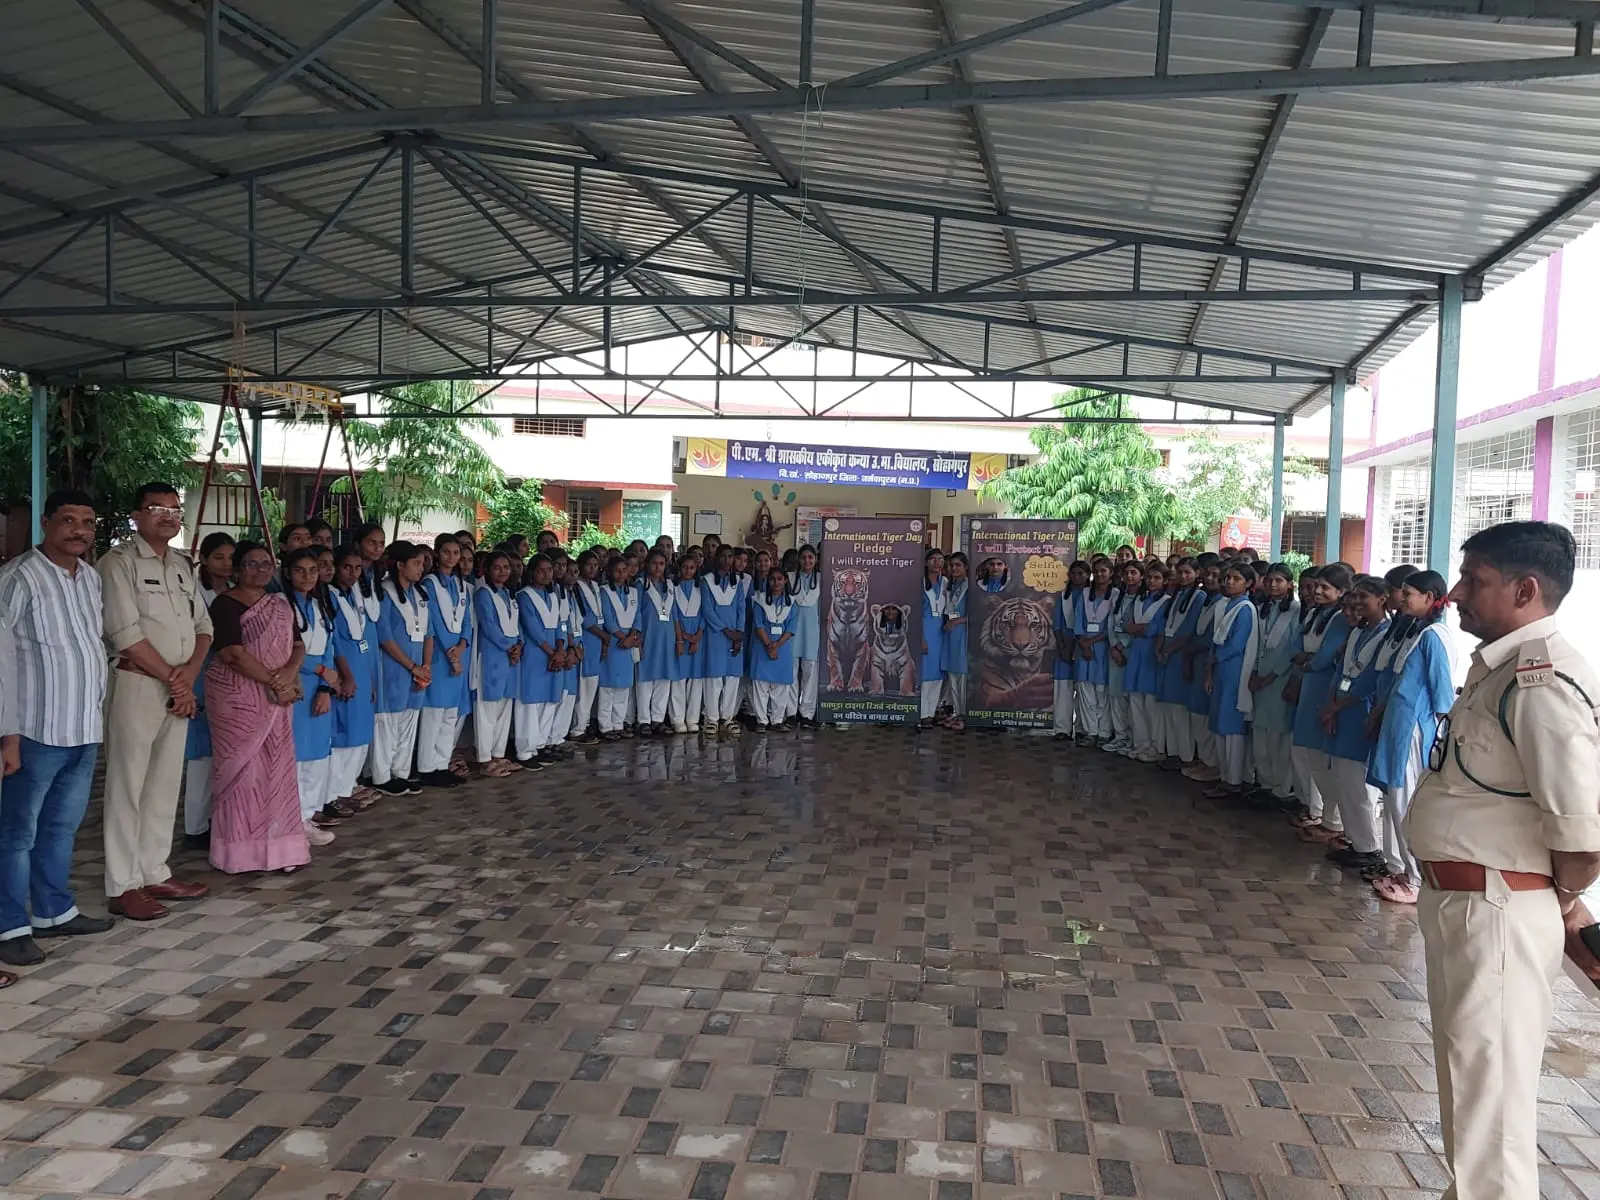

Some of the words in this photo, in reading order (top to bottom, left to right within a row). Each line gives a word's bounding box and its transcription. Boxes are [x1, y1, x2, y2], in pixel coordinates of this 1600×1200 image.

[765, 444, 777, 463] श्री
[778, 447, 814, 466] शासकीय
[816, 448, 847, 472] एकीकृत
[849, 454, 870, 469] कन्या
[933, 455, 969, 478] सोहागपुर
[824, 531, 880, 541] International
[882, 532, 905, 544] Tiger
[905, 533, 923, 544] Day
[971, 530, 1030, 540] International
[1032, 531, 1056, 543] Tiger
[1057, 532, 1076, 543] Day
[853, 543, 892, 555] Pledge
[977, 544, 983, 553] I
[984, 544, 1003, 553] will
[1005, 544, 1042, 554] Protect
[1042, 544, 1070, 555] Tiger
[831, 557, 835, 565] I
[837, 557, 854, 565] will
[855, 557, 889, 566] Protect
[890, 557, 914, 568] Tiger
[1029, 561, 1062, 569] Selfie
[1036, 580, 1055, 588] Me
